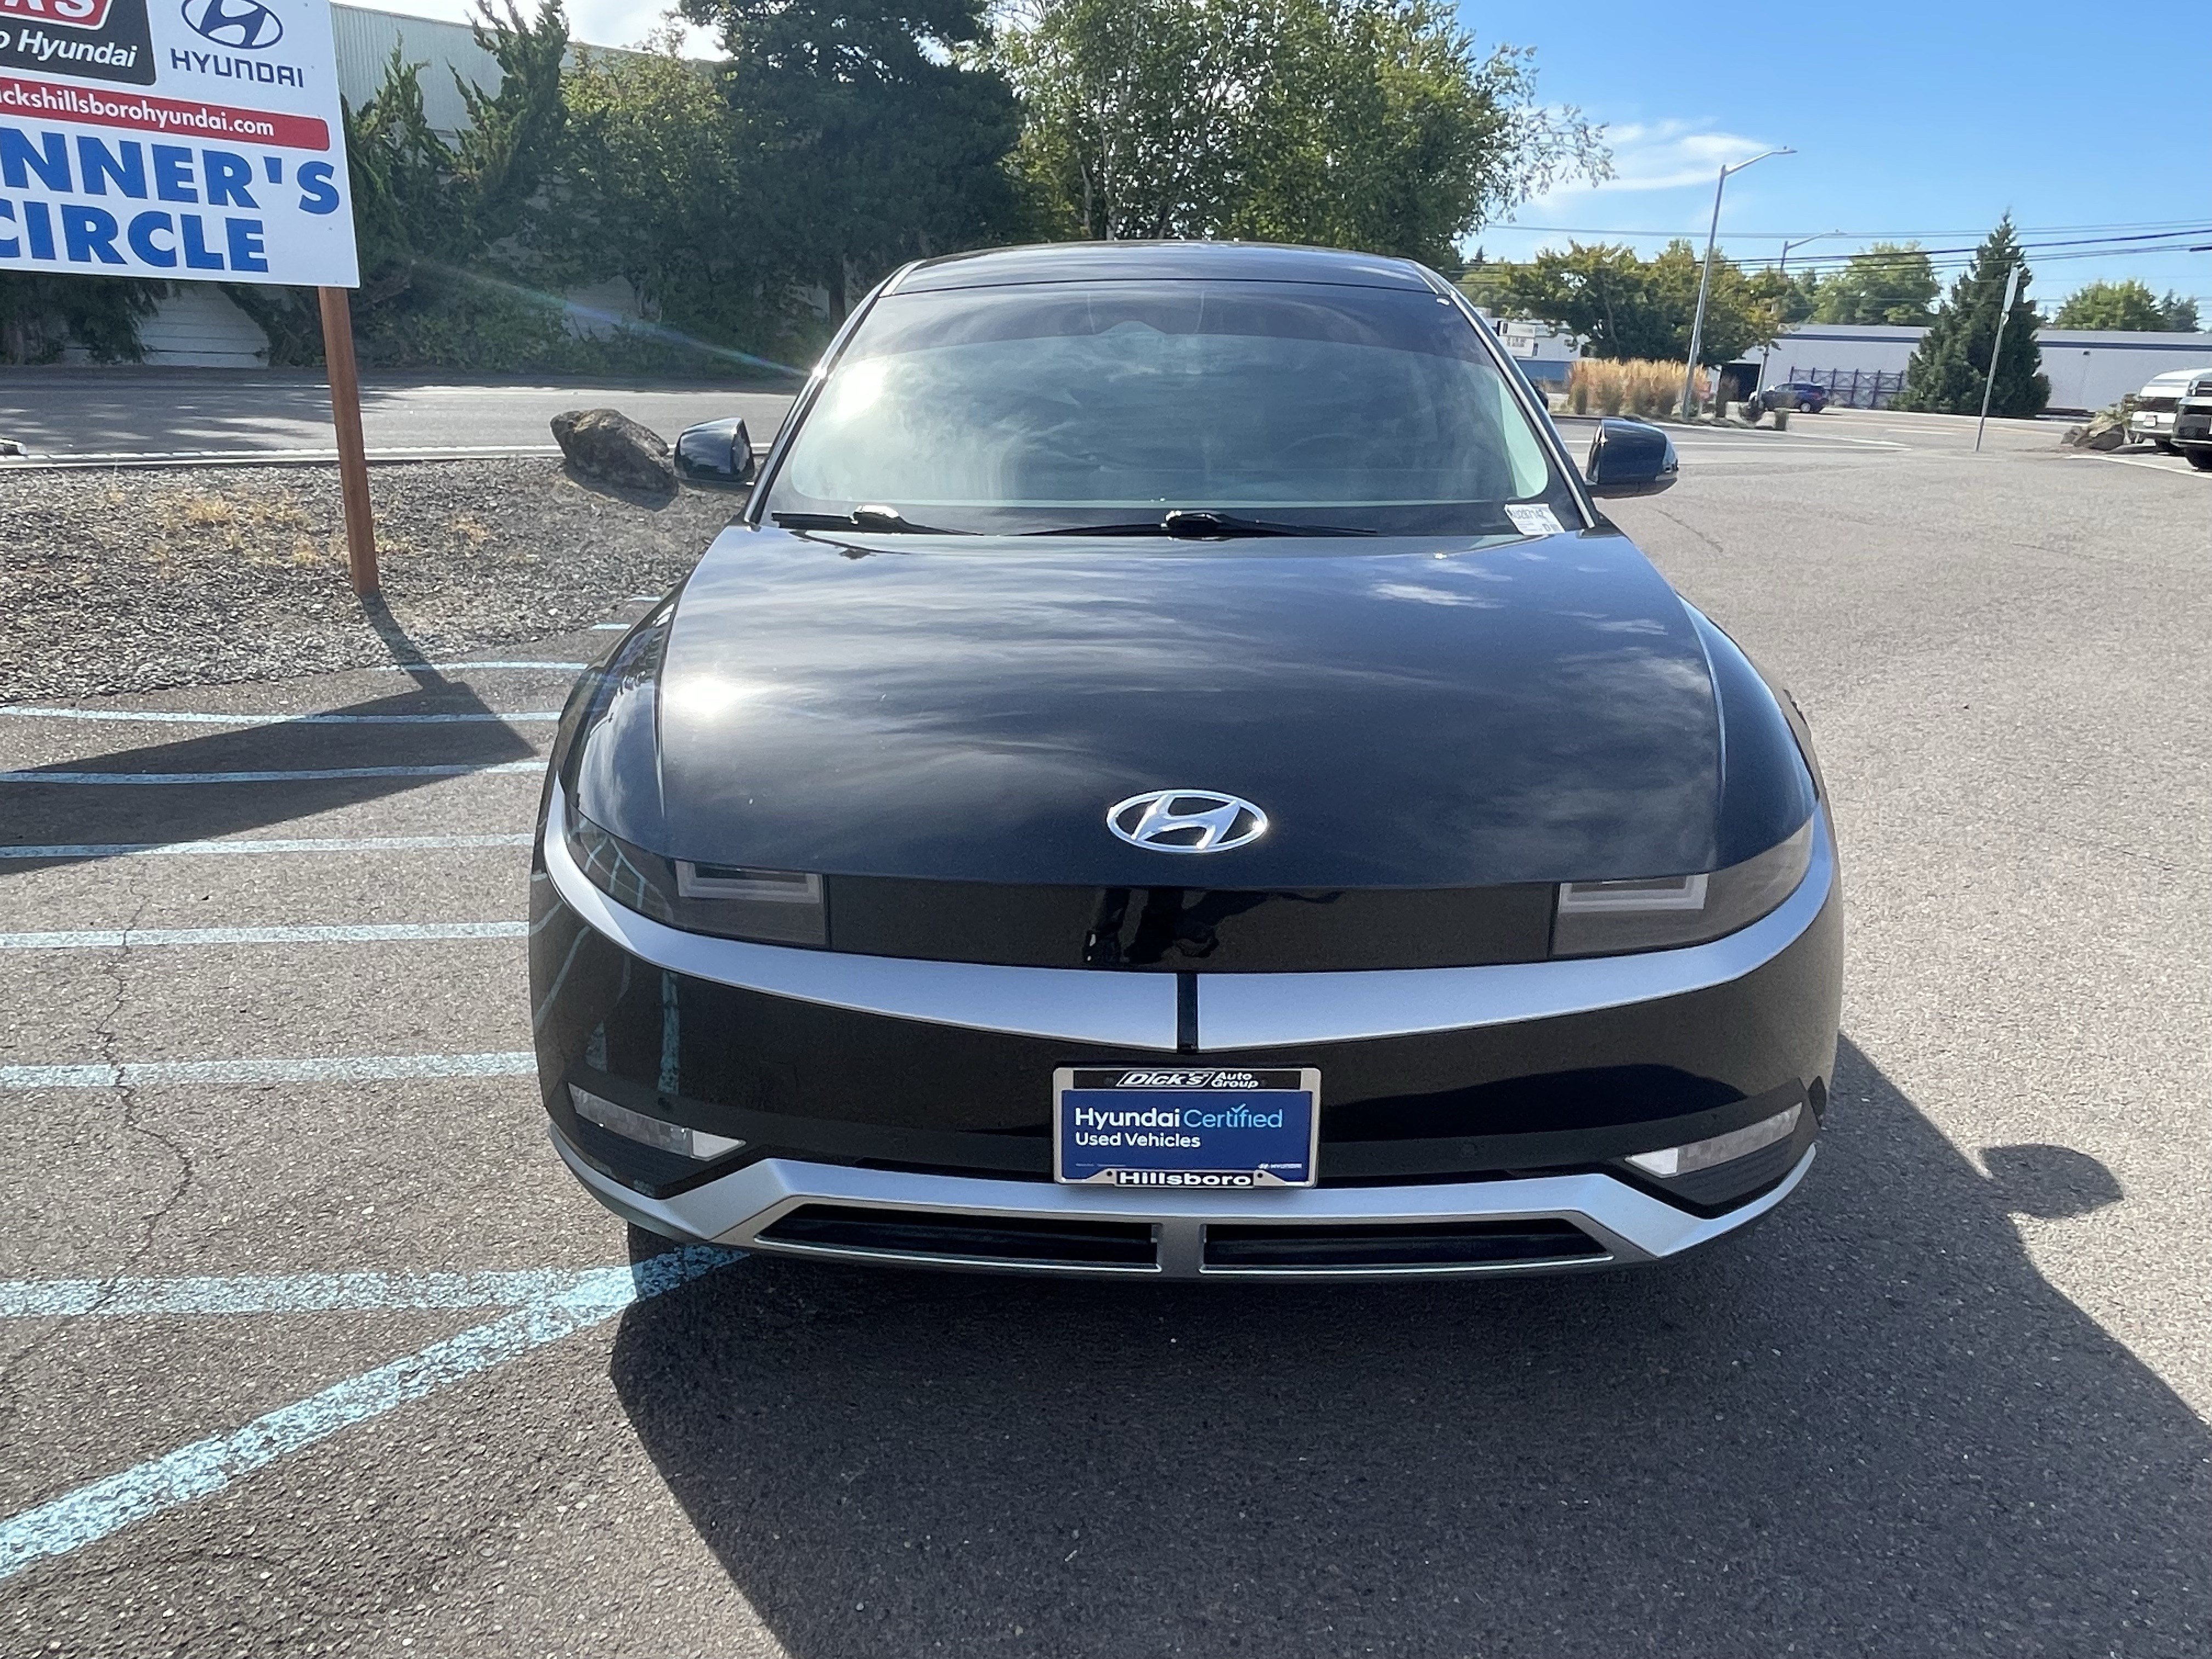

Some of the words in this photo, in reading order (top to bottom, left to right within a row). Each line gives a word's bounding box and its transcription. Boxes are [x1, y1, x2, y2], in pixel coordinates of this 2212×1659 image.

[17, 29, 138, 67] Hyundai
[170, 48, 304, 88] HYUNDAI
[1211, 1079, 1259, 1088] Group
[1216, 1071, 1252, 1080] Auto
[1075, 1107, 1181, 1130] Hyundai
[1183, 1104, 1283, 1128] Certified
[1075, 1132, 1121, 1147] Used
[1125, 1132, 1201, 1148] Vehicles
[1119, 1172, 1252, 1186] Hillsboro
